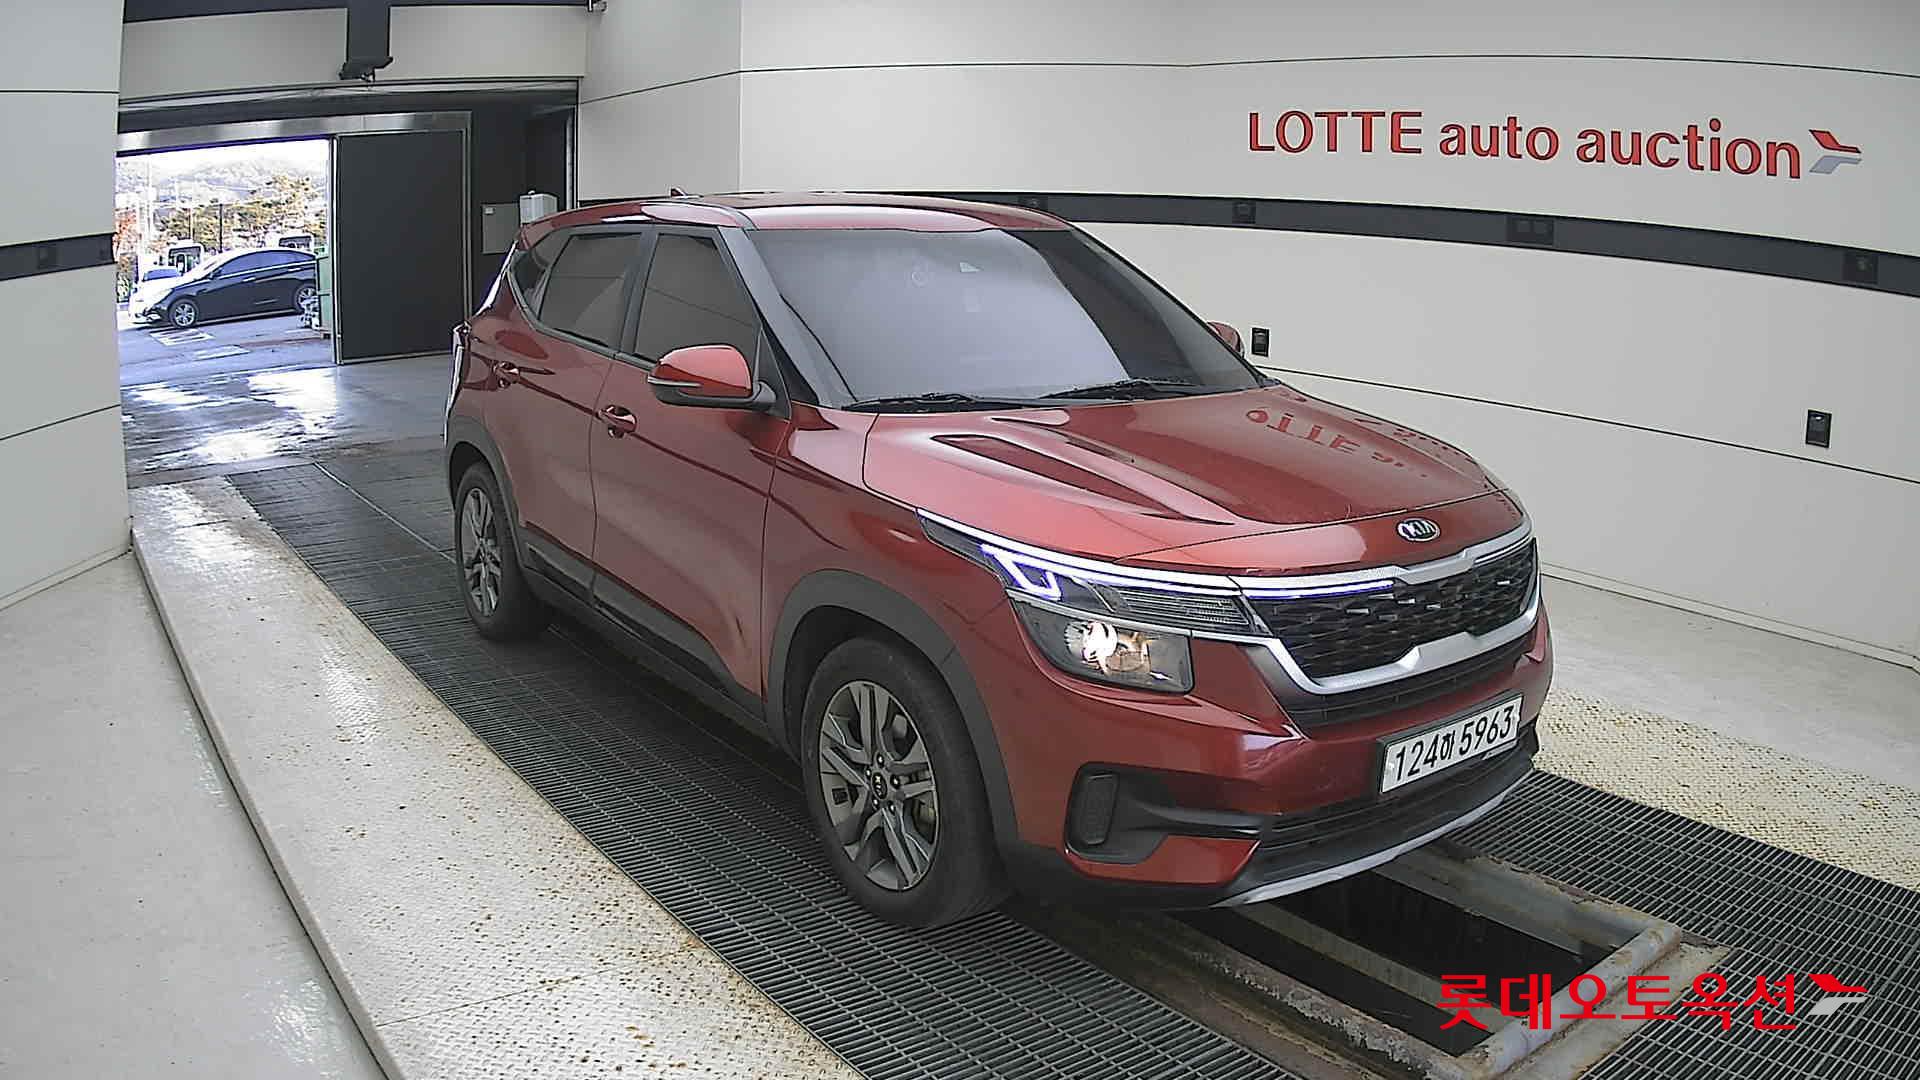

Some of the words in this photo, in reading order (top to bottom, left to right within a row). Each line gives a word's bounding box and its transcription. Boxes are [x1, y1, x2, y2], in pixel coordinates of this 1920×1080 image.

[1249, 110, 1422, 154] LOTTE
[1440, 116, 1560, 160] auto
[1577, 118, 1801, 179] auction
[1403, 519, 1437, 538] KIA
[1459, 705, 1514, 755] 5963
